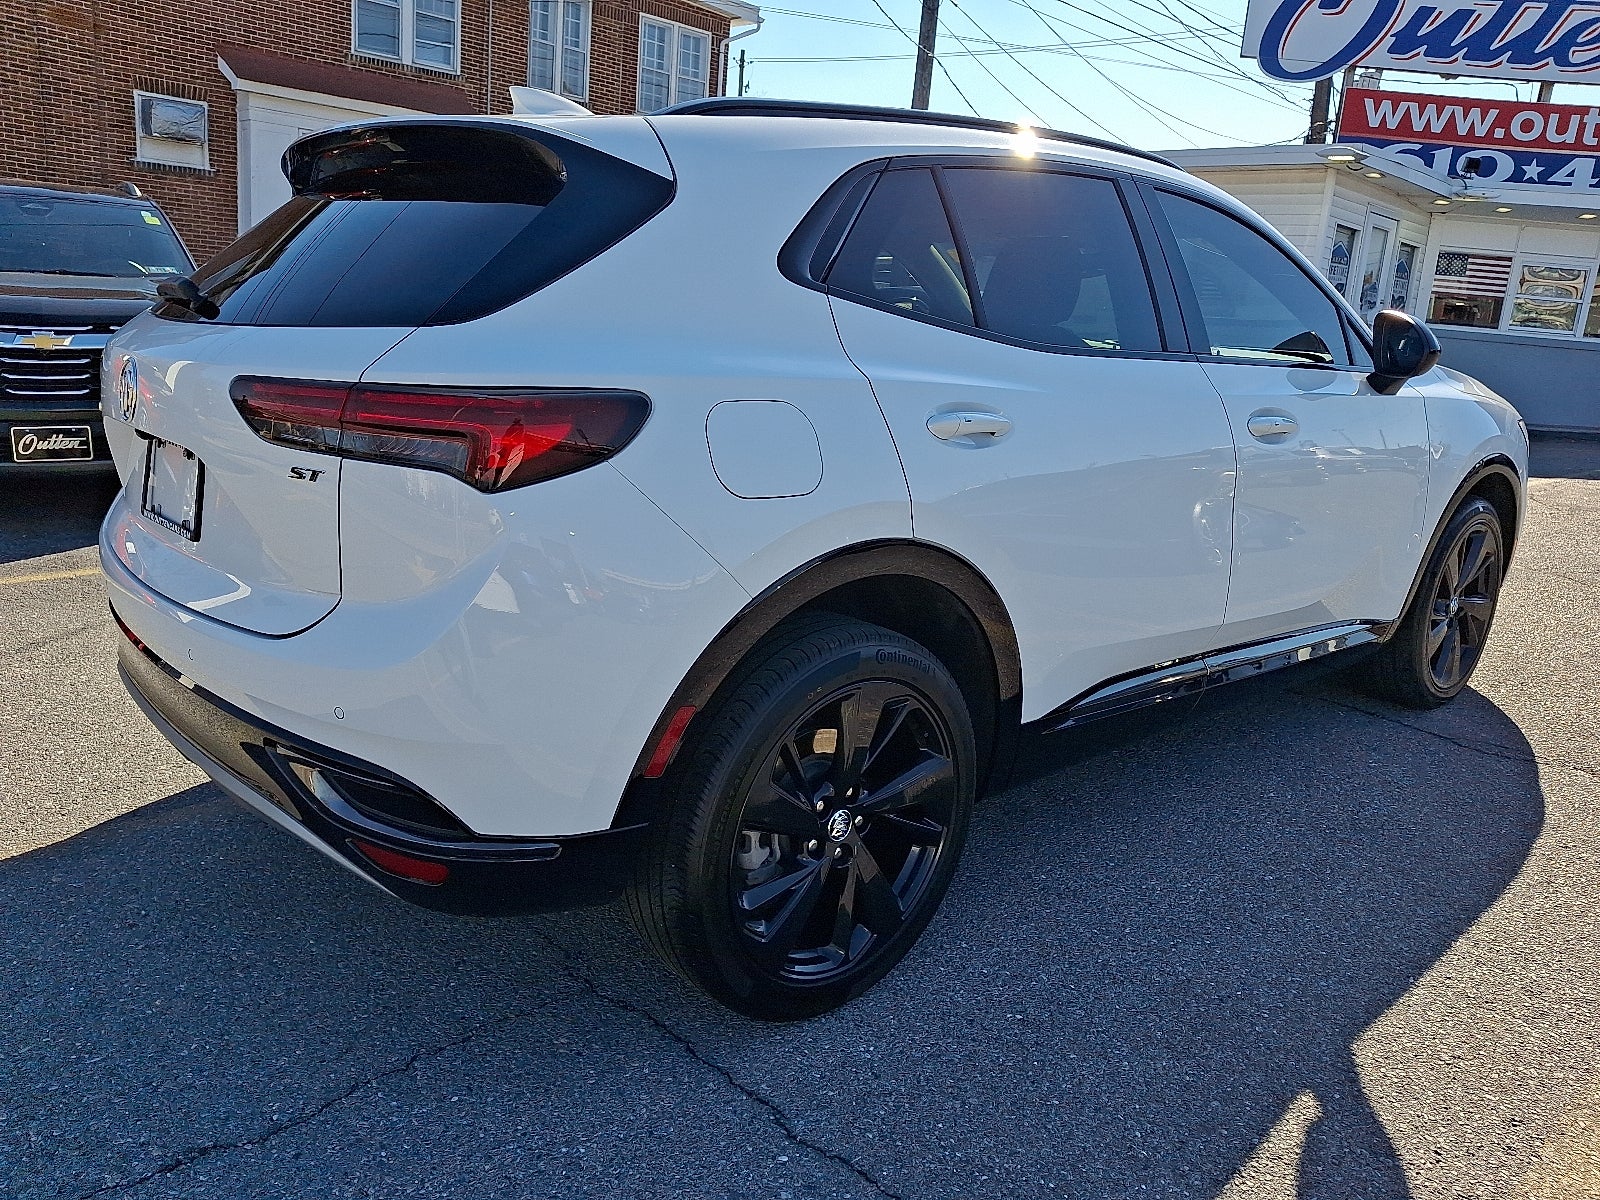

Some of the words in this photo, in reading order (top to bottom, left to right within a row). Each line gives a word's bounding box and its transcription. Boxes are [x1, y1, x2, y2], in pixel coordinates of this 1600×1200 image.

[1363, 97, 1600, 146] www.out
[18, 433, 88, 455] Outten
[287, 466, 327, 482] ST
[875, 648, 931, 674] Continental
